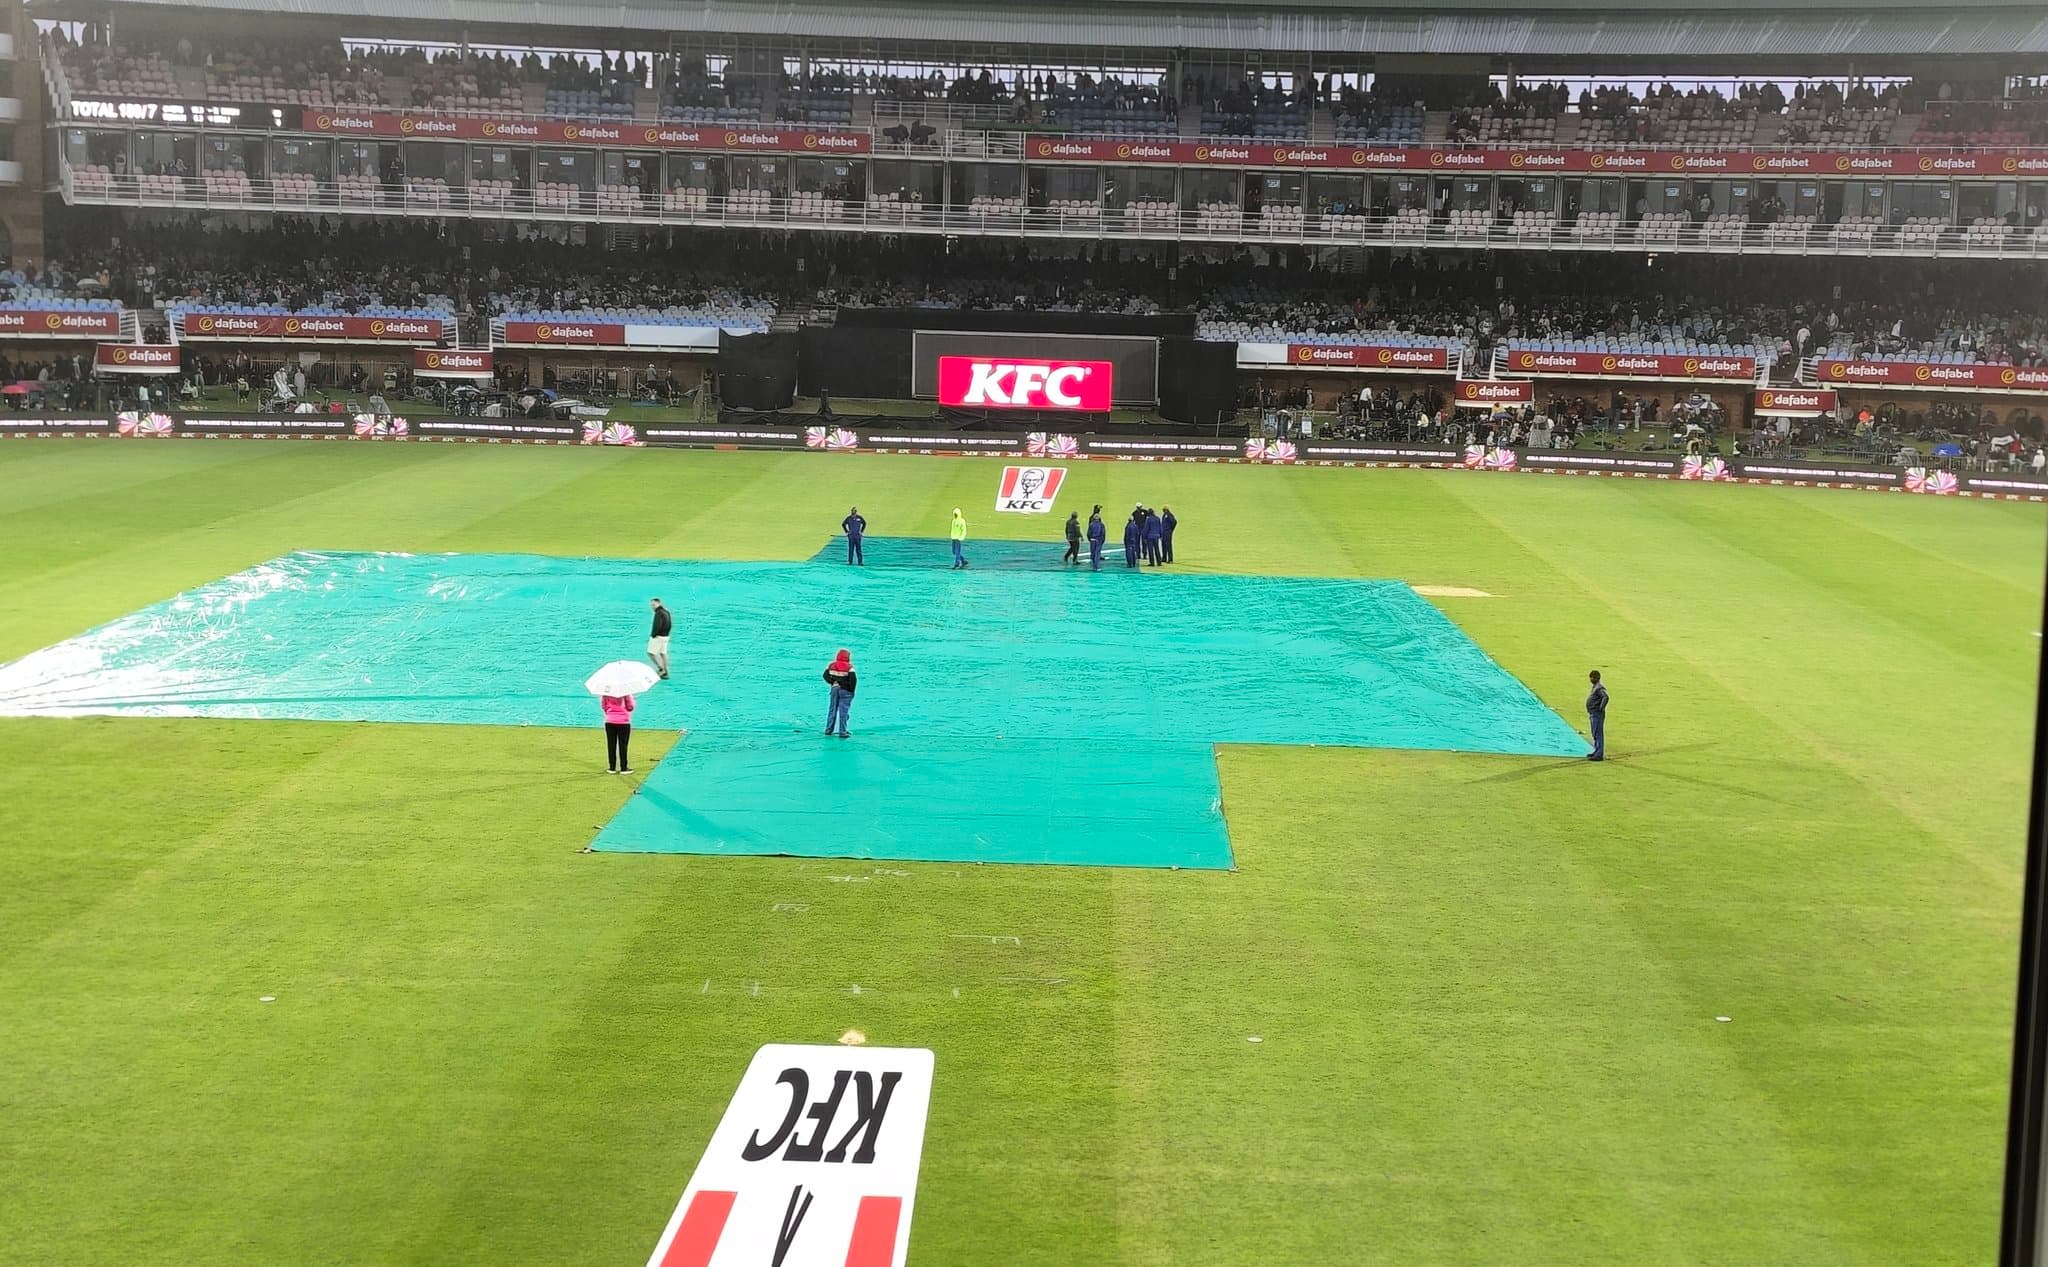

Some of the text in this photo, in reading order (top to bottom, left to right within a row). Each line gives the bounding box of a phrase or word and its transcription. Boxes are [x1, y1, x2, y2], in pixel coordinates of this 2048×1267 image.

[71, 101, 118, 118] TOTAL
[332, 117, 373, 128] dafabet
[415, 121, 456, 132] dafabet
[498, 124, 537, 135] dafabet
[579, 128, 619, 139] dafabet
[660, 131, 699, 142] dafabet
[740, 134, 778, 145] dafabet
[818, 136, 857, 147] dafabet
[1053, 144, 1091, 155] dafabet
[1132, 146, 1170, 157] dafabet
[1210, 148, 1248, 159] dafabet
[1288, 151, 1326, 162] dafabet
[1367, 153, 1405, 164] dafabet
[1445, 154, 1484, 165] dafabet
[1525, 155, 1564, 166] dafabet
[1605, 156, 1645, 167] dafabet
[1686, 157, 1726, 168] dafabet
[1768, 158, 1808, 169] dafabet
[1851, 158, 1892, 169] dafabet
[1934, 159, 1975, 170] dafabet
[63, 316, 106, 327] dafabet
[215, 318, 258, 329] dafabet
[301, 320, 343, 331] dafabet
[386, 323, 428, 334] dafabet
[552, 327, 593, 338] dafabet
[129, 350, 171, 361] dafabet
[1313, 349, 1353, 360] dafabet
[1393, 351, 1433, 362] dafabet
[441, 356, 481, 367] dafabet
[1536, 356, 1576, 367] dafabet
[1617, 358, 1658, 369] dafabet
[1699, 360, 1740, 371] dafabet
[1846, 365, 1888, 376] dafabet
[1931, 368, 1973, 379] dafabet
[964, 363, 1085, 406] KFC
[1479, 386, 1519, 397] dafabet
[1775, 395, 1818, 406] dafabet
[1004, 500, 1044, 510] KFC
[741, 1067, 902, 1164] KFC
